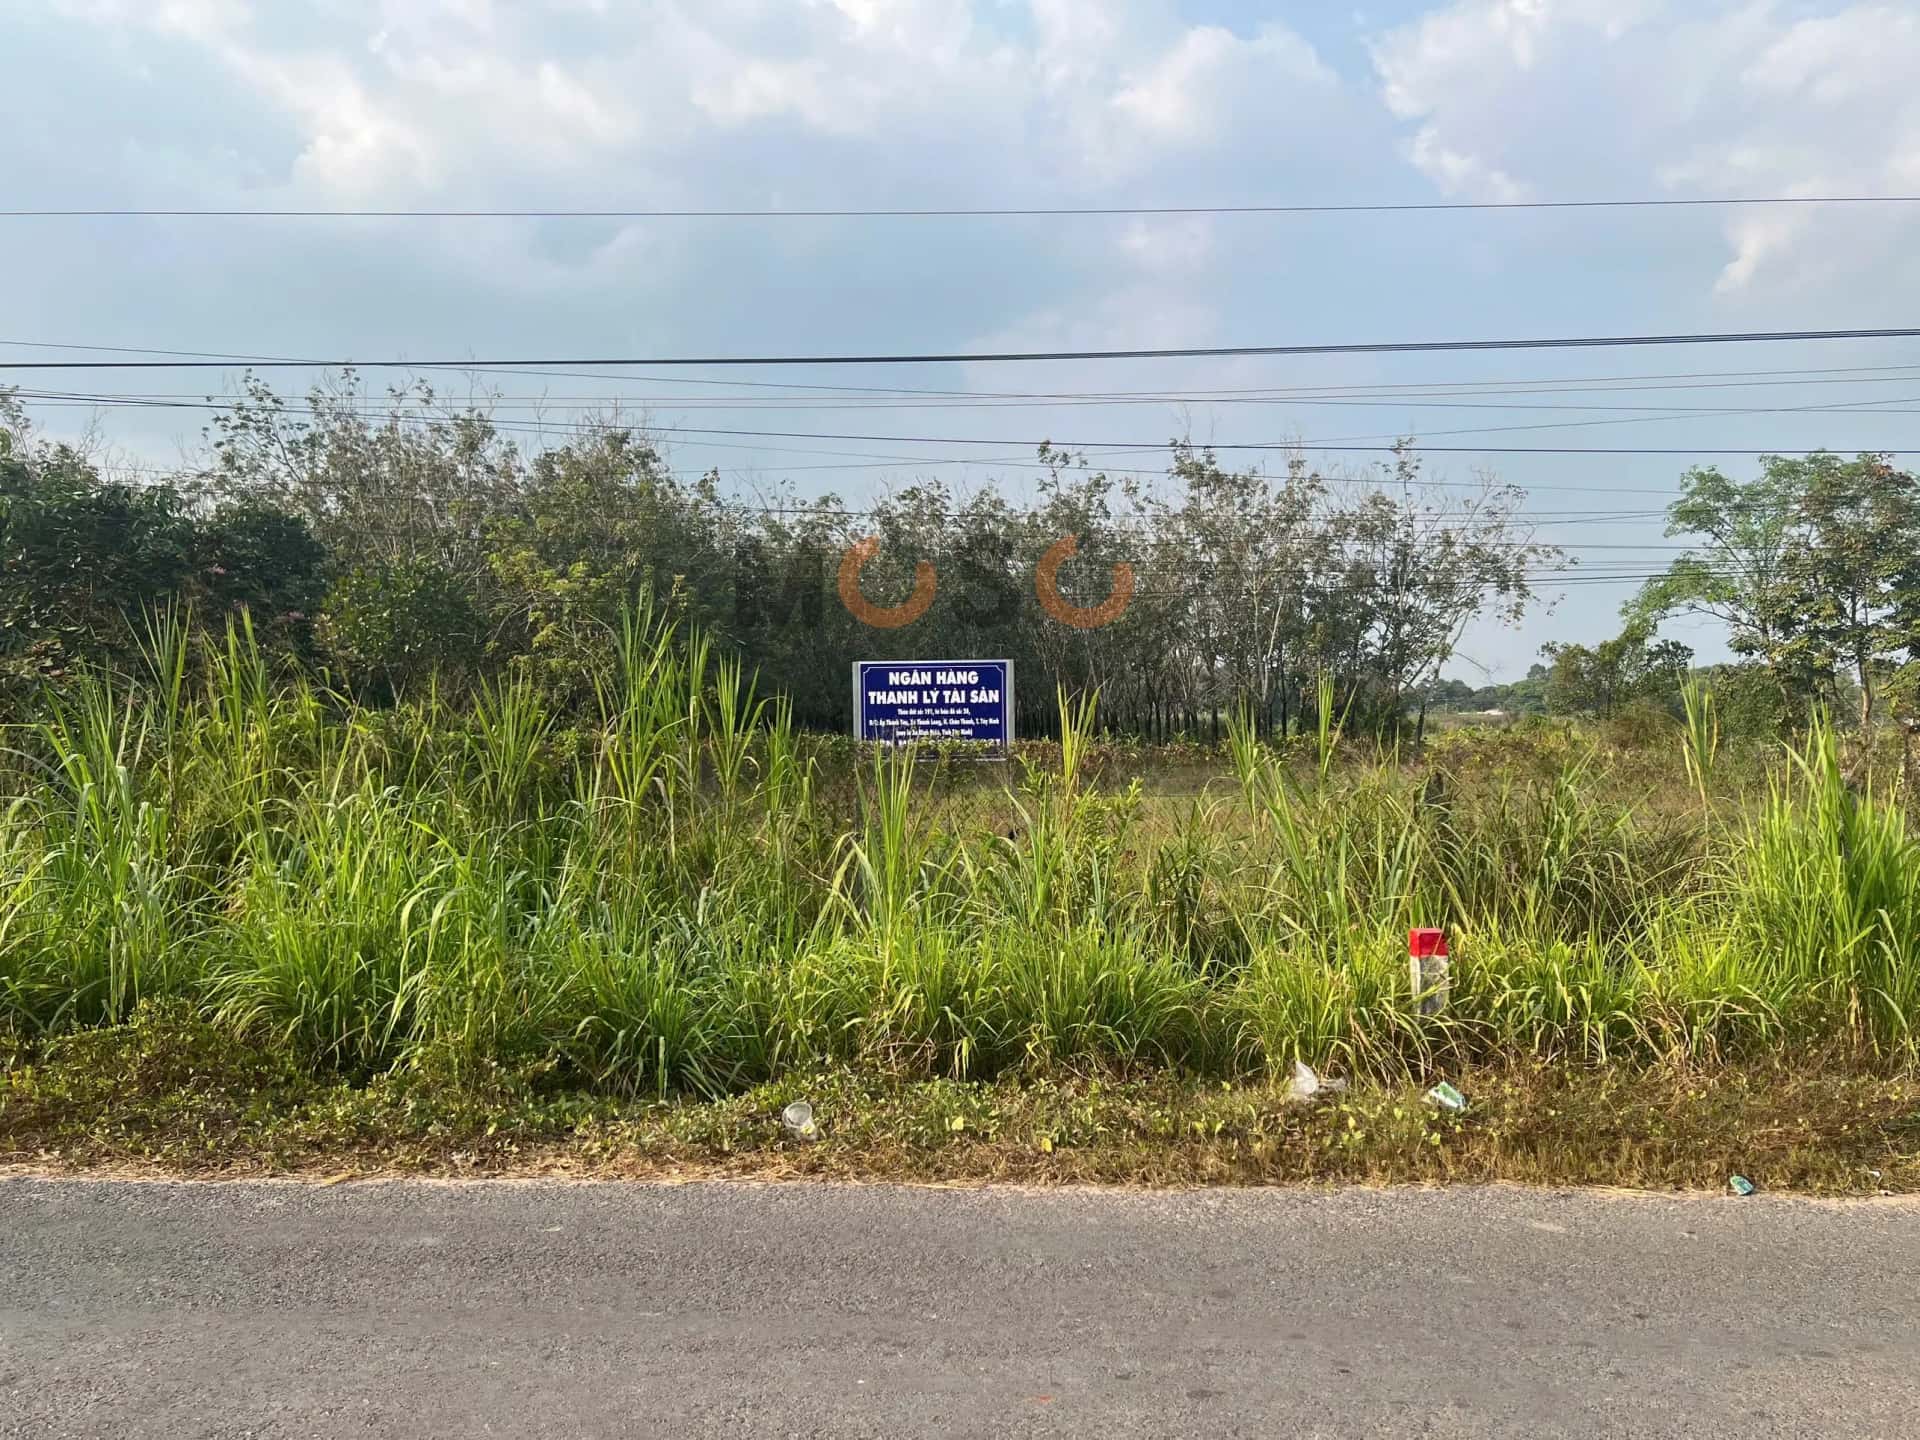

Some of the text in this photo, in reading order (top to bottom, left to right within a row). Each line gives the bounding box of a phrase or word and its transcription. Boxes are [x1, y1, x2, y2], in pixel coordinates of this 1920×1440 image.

[888, 669, 979, 686] NGÂN HÀNG
[868, 686, 999, 705] THANH LÝ TÀI SẢN
